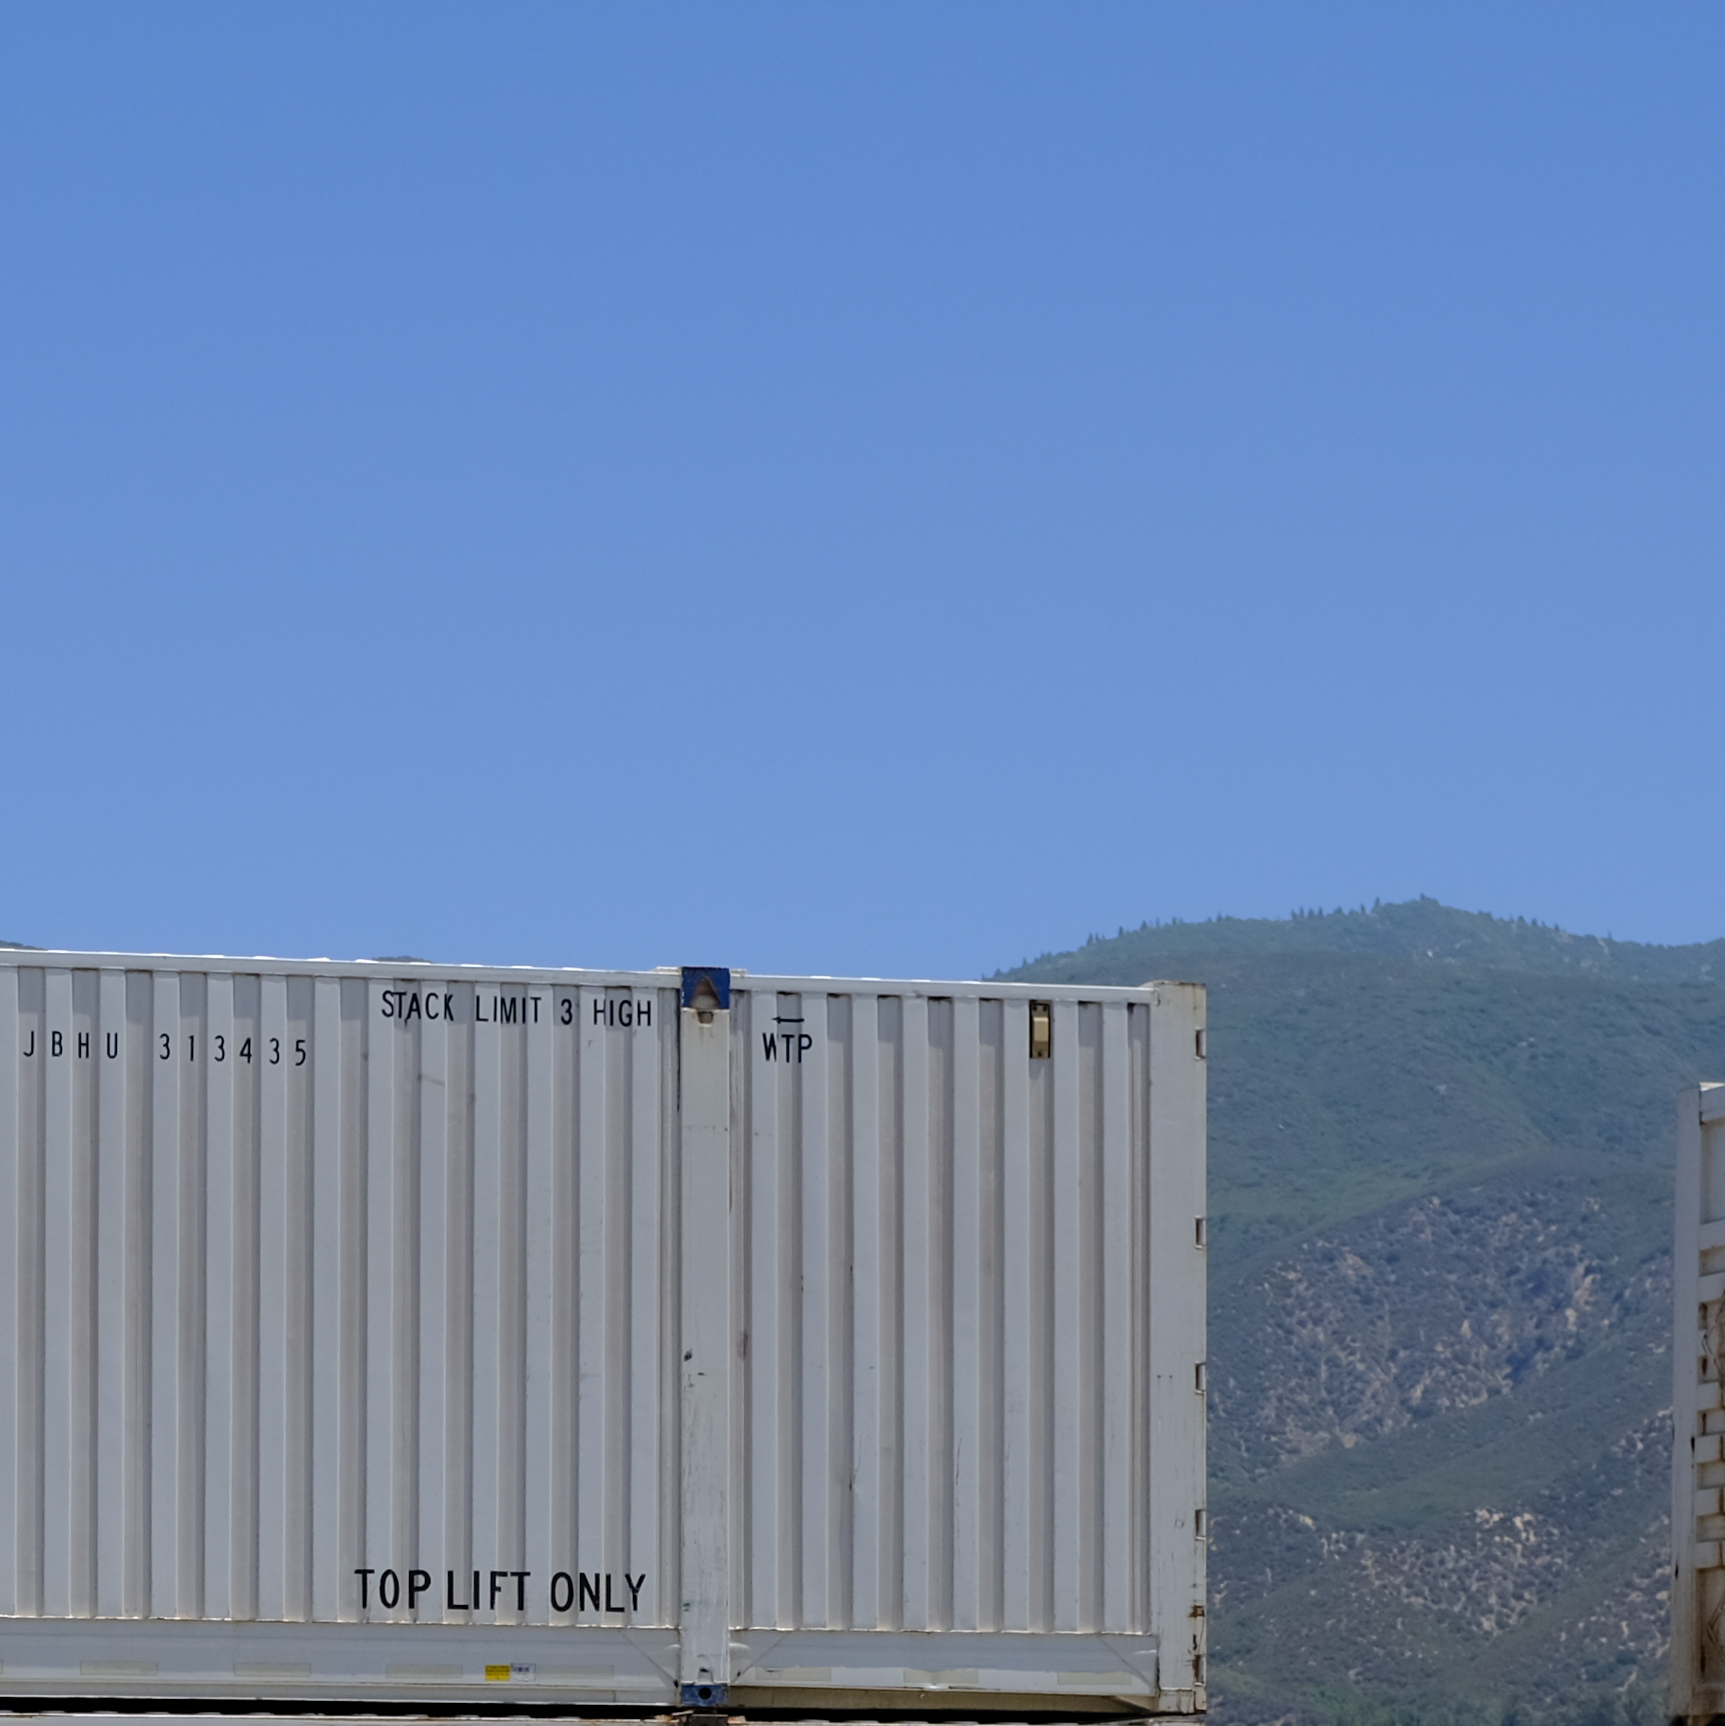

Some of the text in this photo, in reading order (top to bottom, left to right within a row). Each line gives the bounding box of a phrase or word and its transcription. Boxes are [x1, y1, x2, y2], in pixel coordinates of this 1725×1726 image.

[381, 990, 652, 1028] STACK LIMIT 3 HIGH
[762, 1033, 813, 1064] WTP
[354, 1569, 647, 1613] TOP LIFT ONLY
